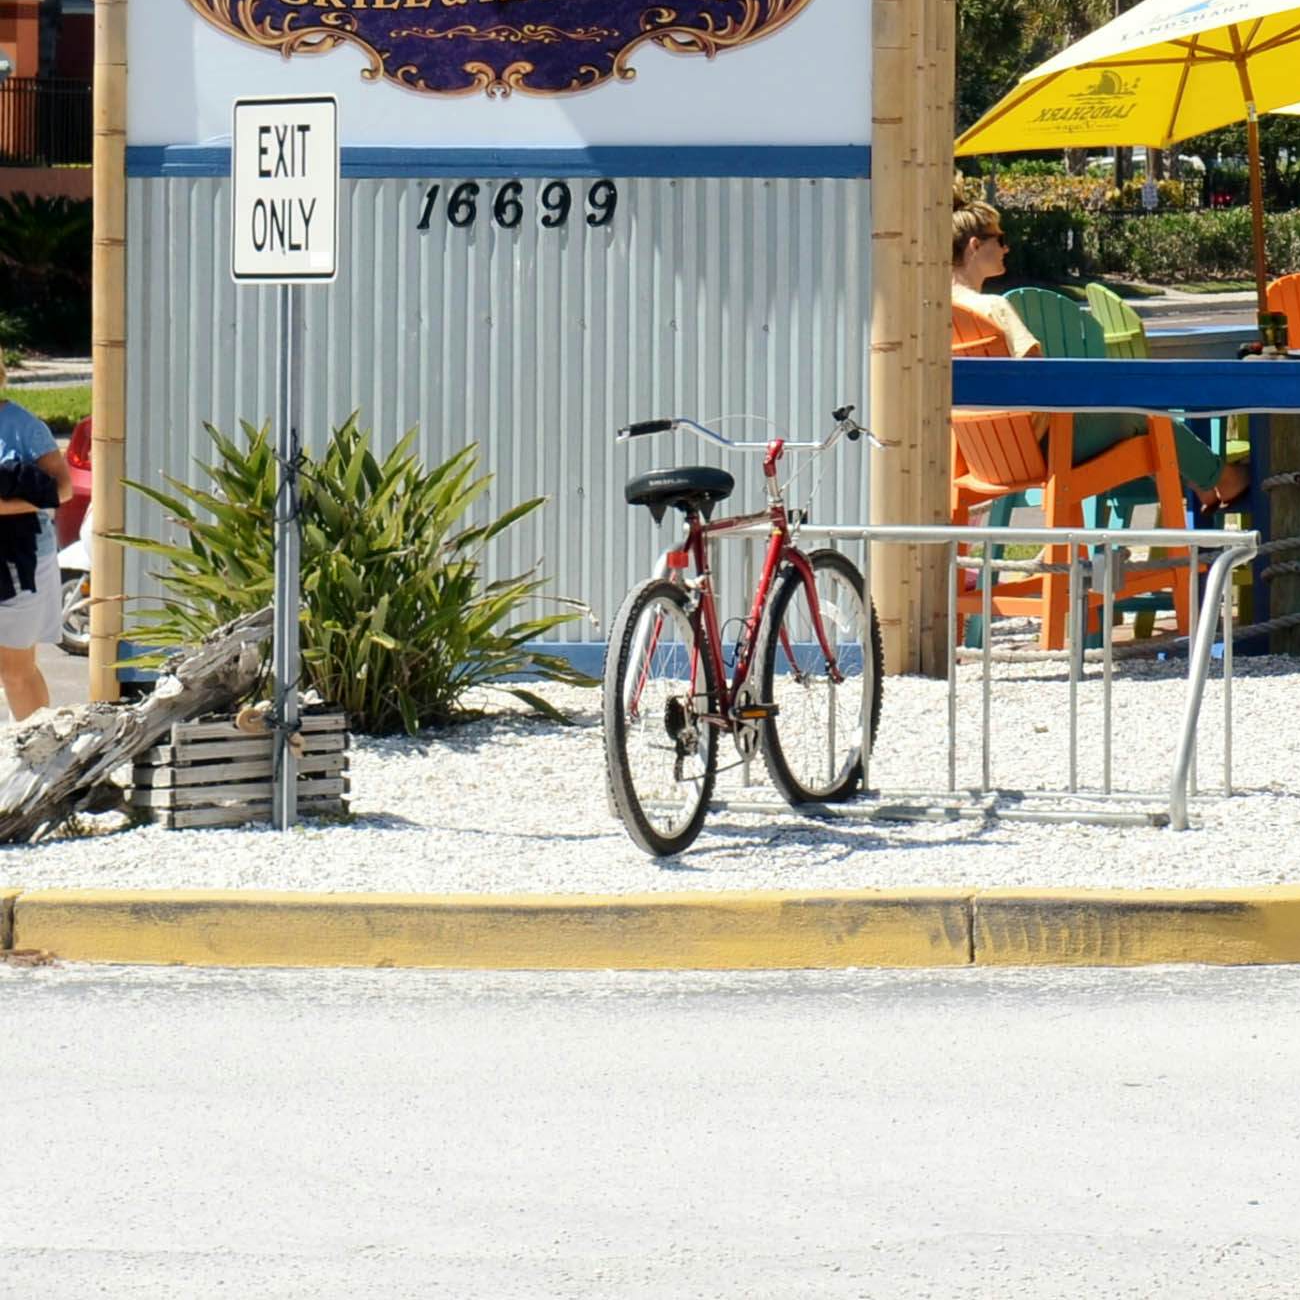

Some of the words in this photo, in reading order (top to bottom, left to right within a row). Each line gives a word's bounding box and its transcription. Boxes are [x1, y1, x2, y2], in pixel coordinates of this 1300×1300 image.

[257, 123, 311, 179] EXIT
[251, 197, 317, 252] ONLY
[416, 180, 618, 230] 16699
